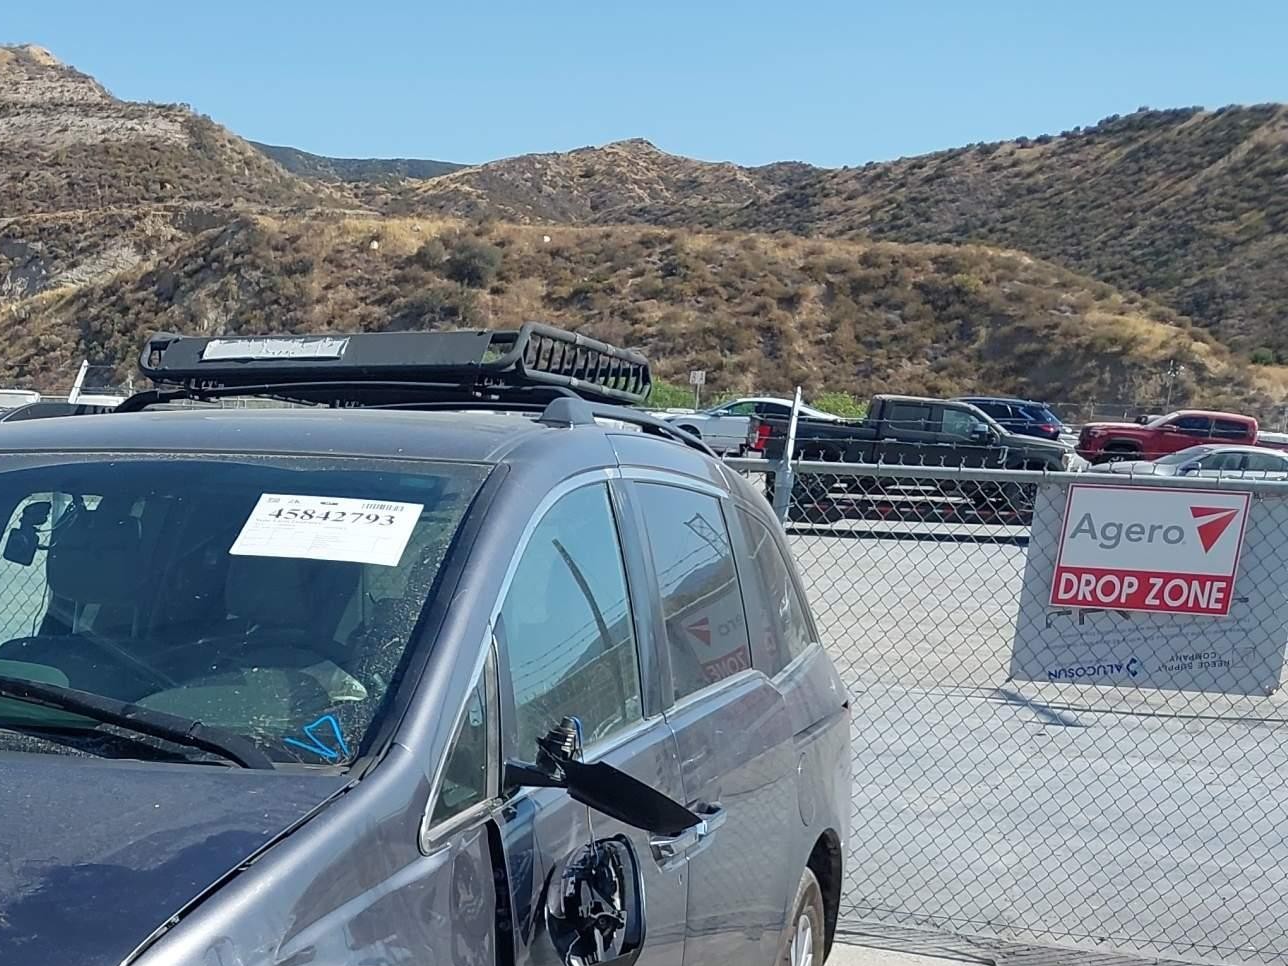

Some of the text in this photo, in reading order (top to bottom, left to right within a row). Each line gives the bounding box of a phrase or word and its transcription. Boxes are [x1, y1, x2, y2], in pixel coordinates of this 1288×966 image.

[268, 507, 396, 526] 45842793
[1069, 512, 1186, 550] Agero
[1057, 572, 1227, 609] DROP ZONE
